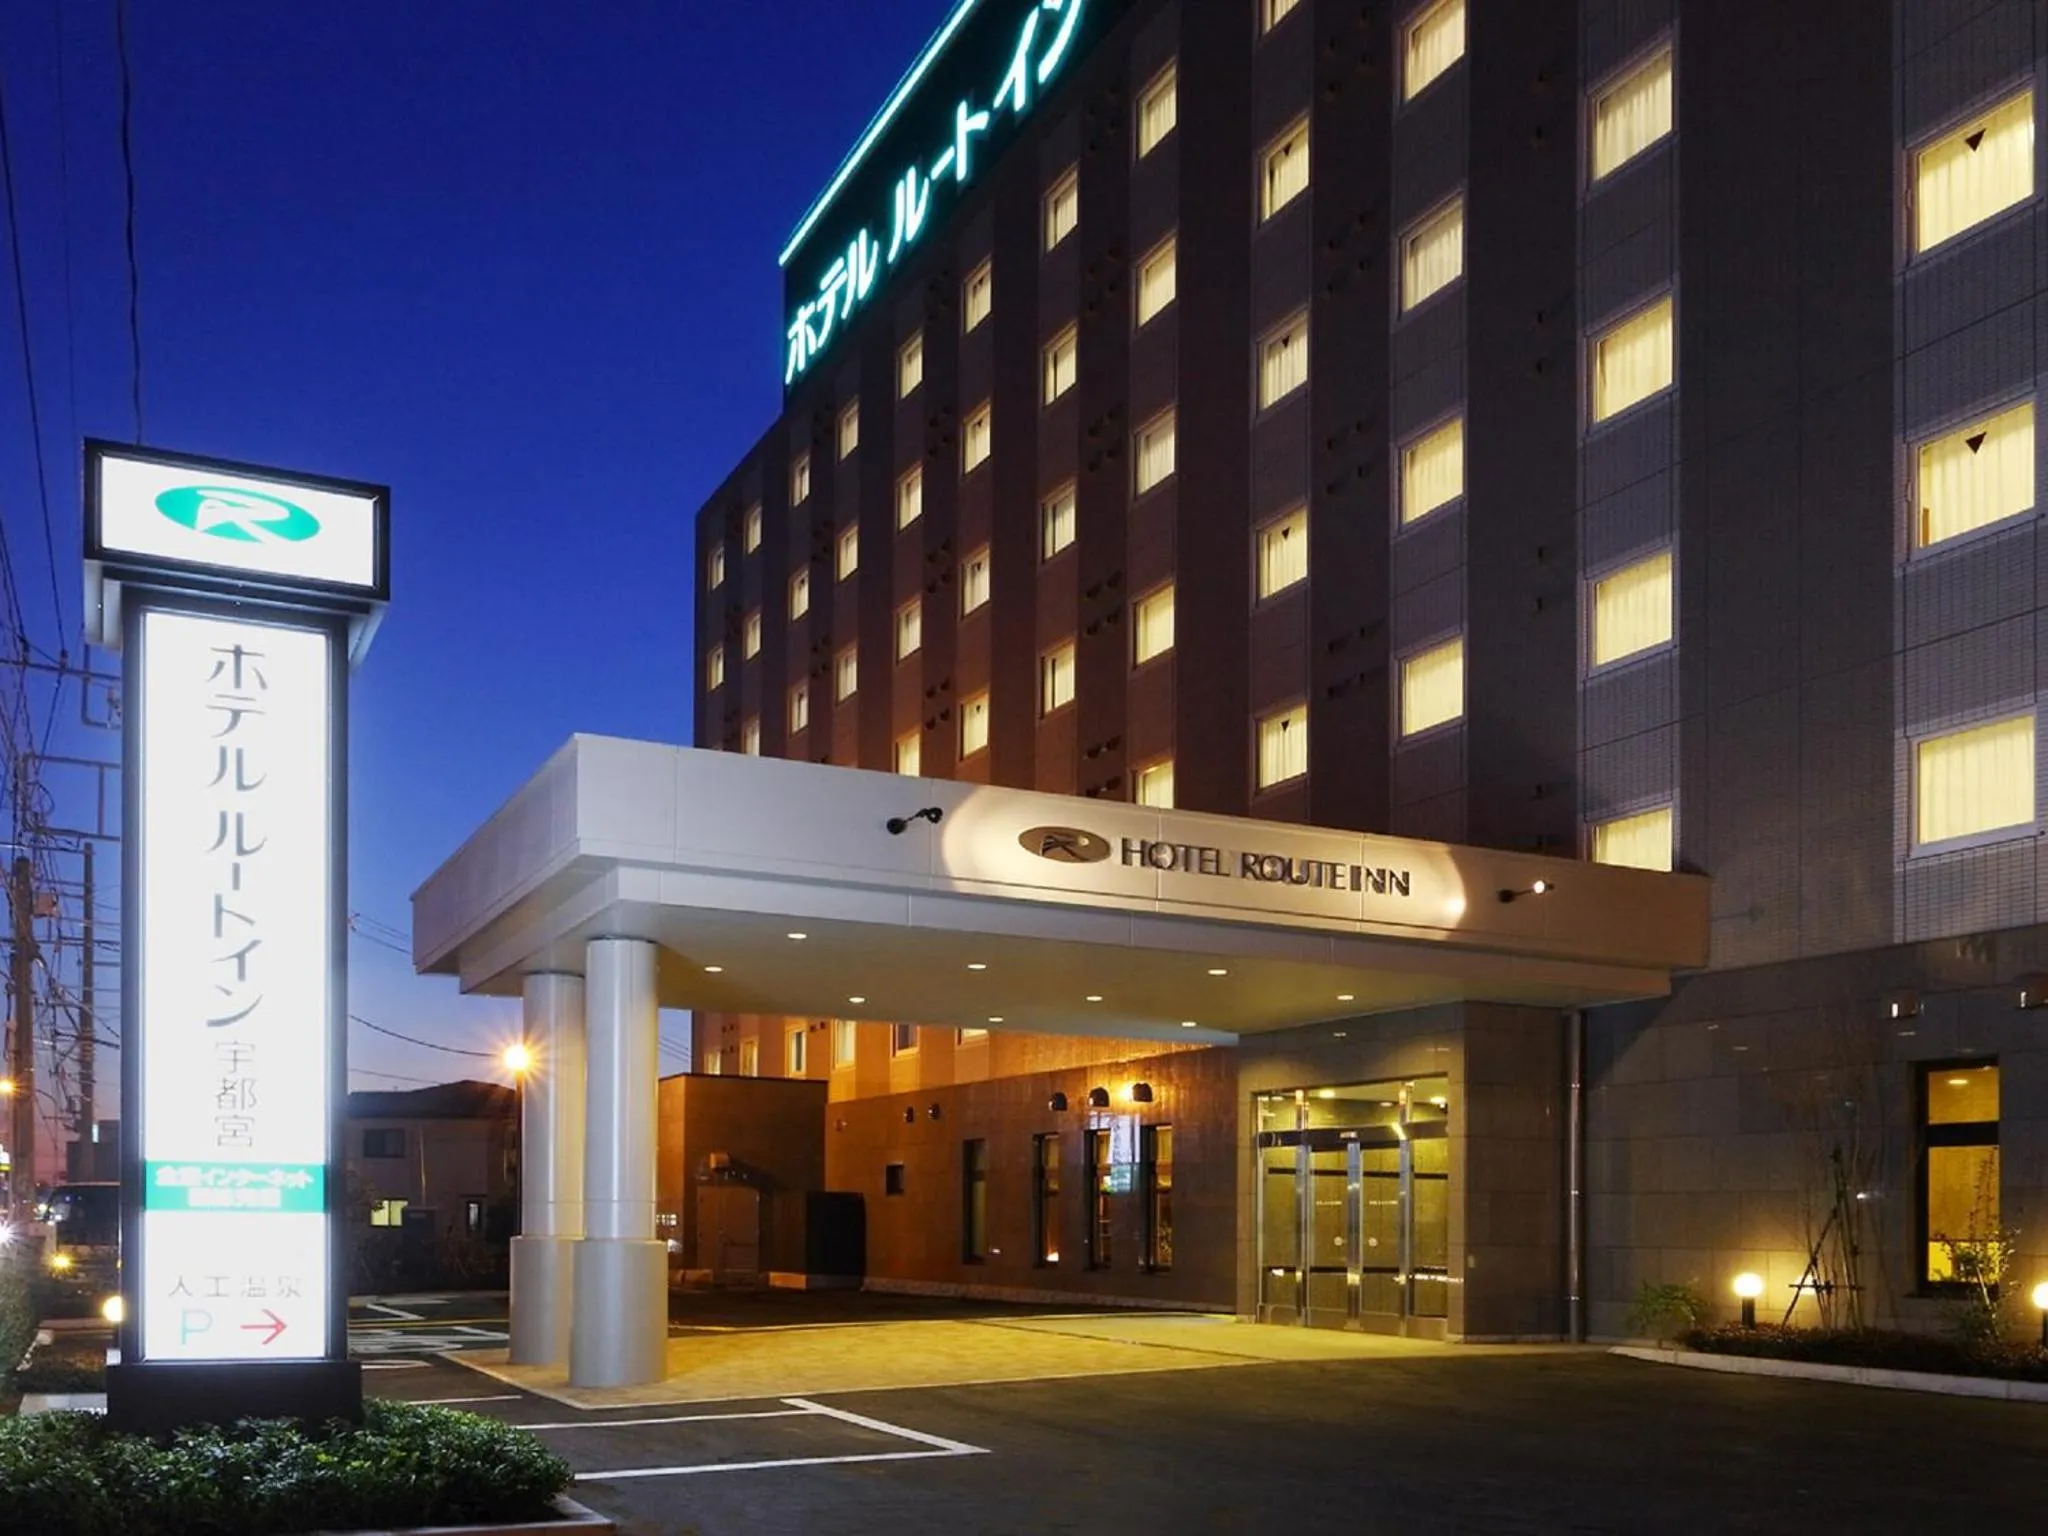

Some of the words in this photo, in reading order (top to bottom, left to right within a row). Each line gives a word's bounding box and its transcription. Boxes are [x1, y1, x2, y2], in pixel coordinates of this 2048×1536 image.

[1121, 837, 1230, 877] HOTEL
[214, 1040, 260, 1147] 宇都宮
[169, 1276, 302, 1298] 人工温泉
[181, 1308, 214, 1347] P
